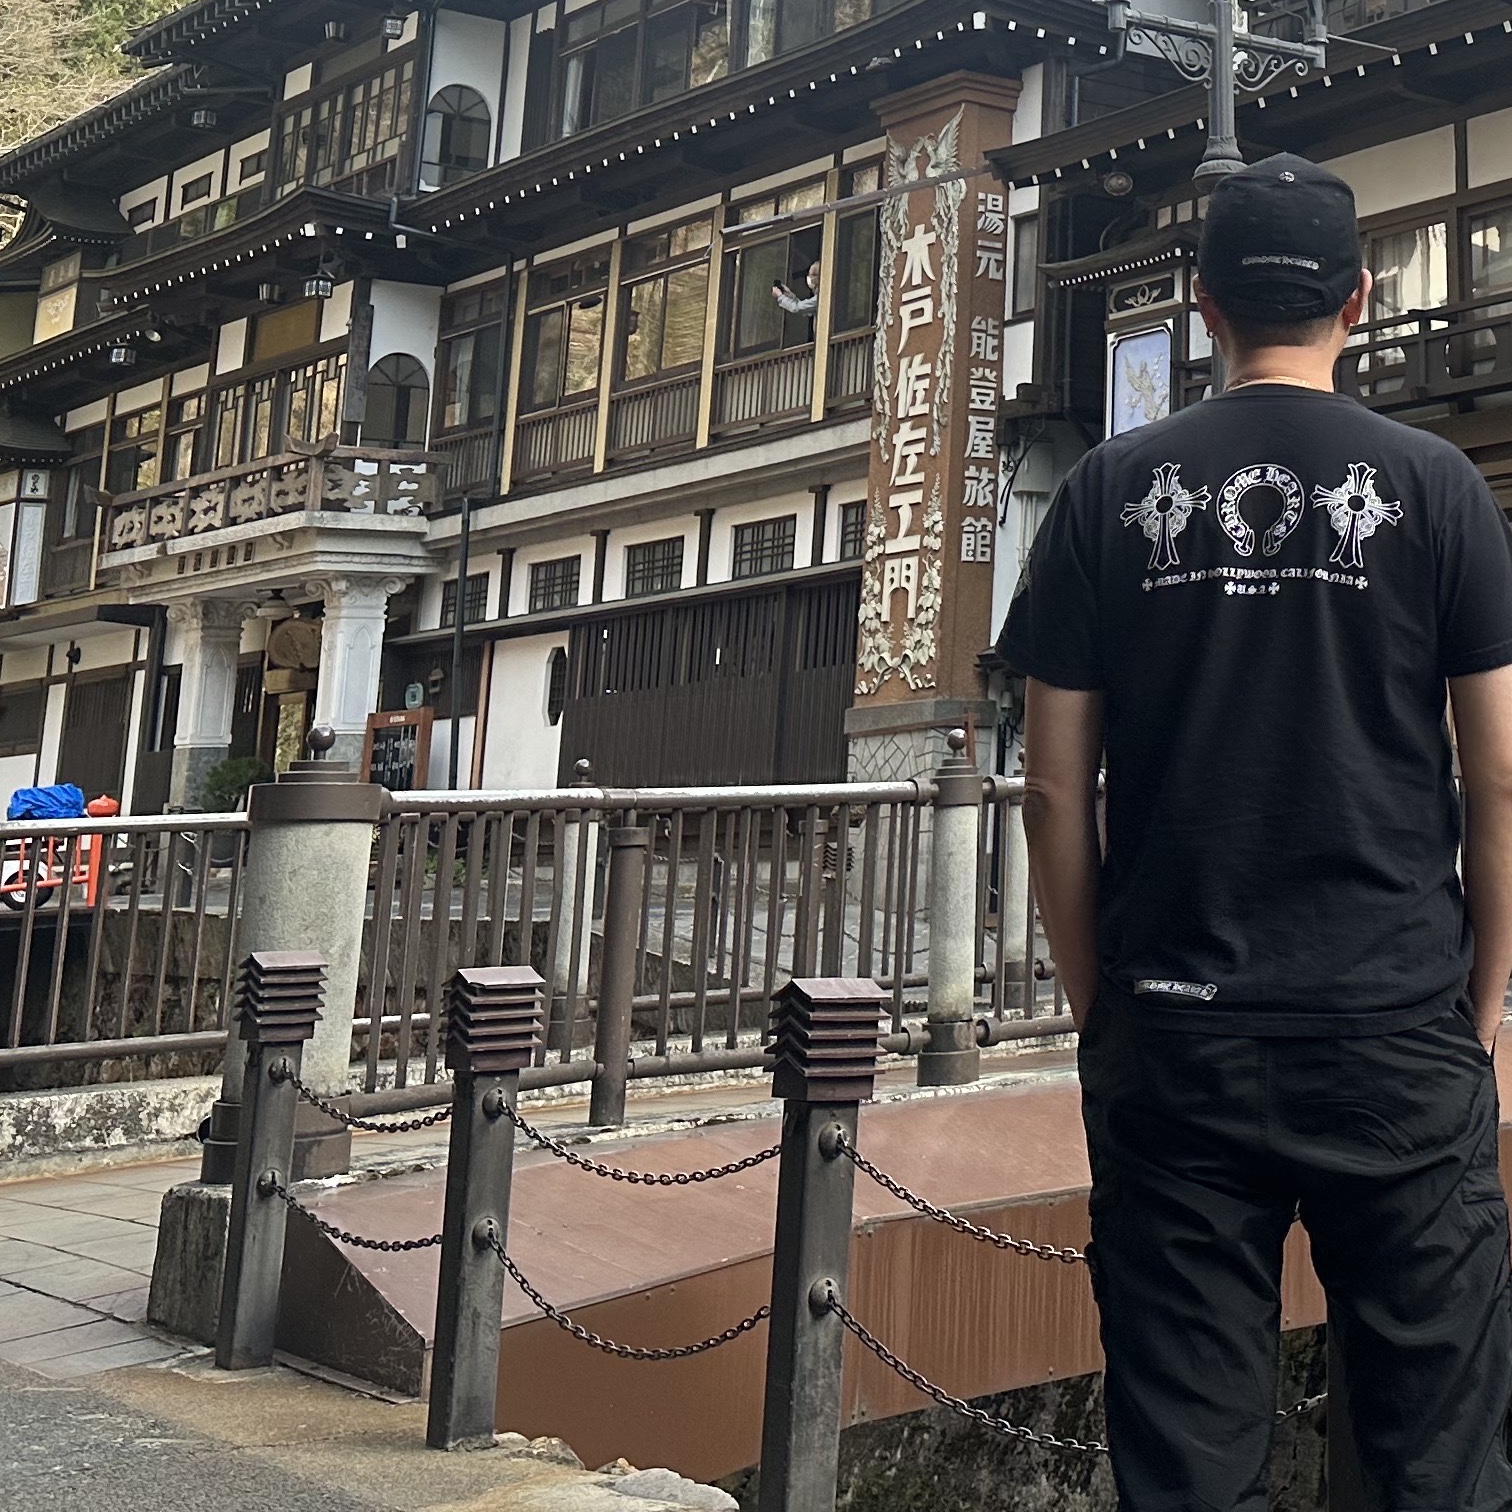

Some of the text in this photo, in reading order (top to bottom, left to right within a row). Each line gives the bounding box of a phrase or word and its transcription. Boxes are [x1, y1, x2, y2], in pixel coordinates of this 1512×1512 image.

[960, 191, 1006, 564] 湯元 能登屋旅館
